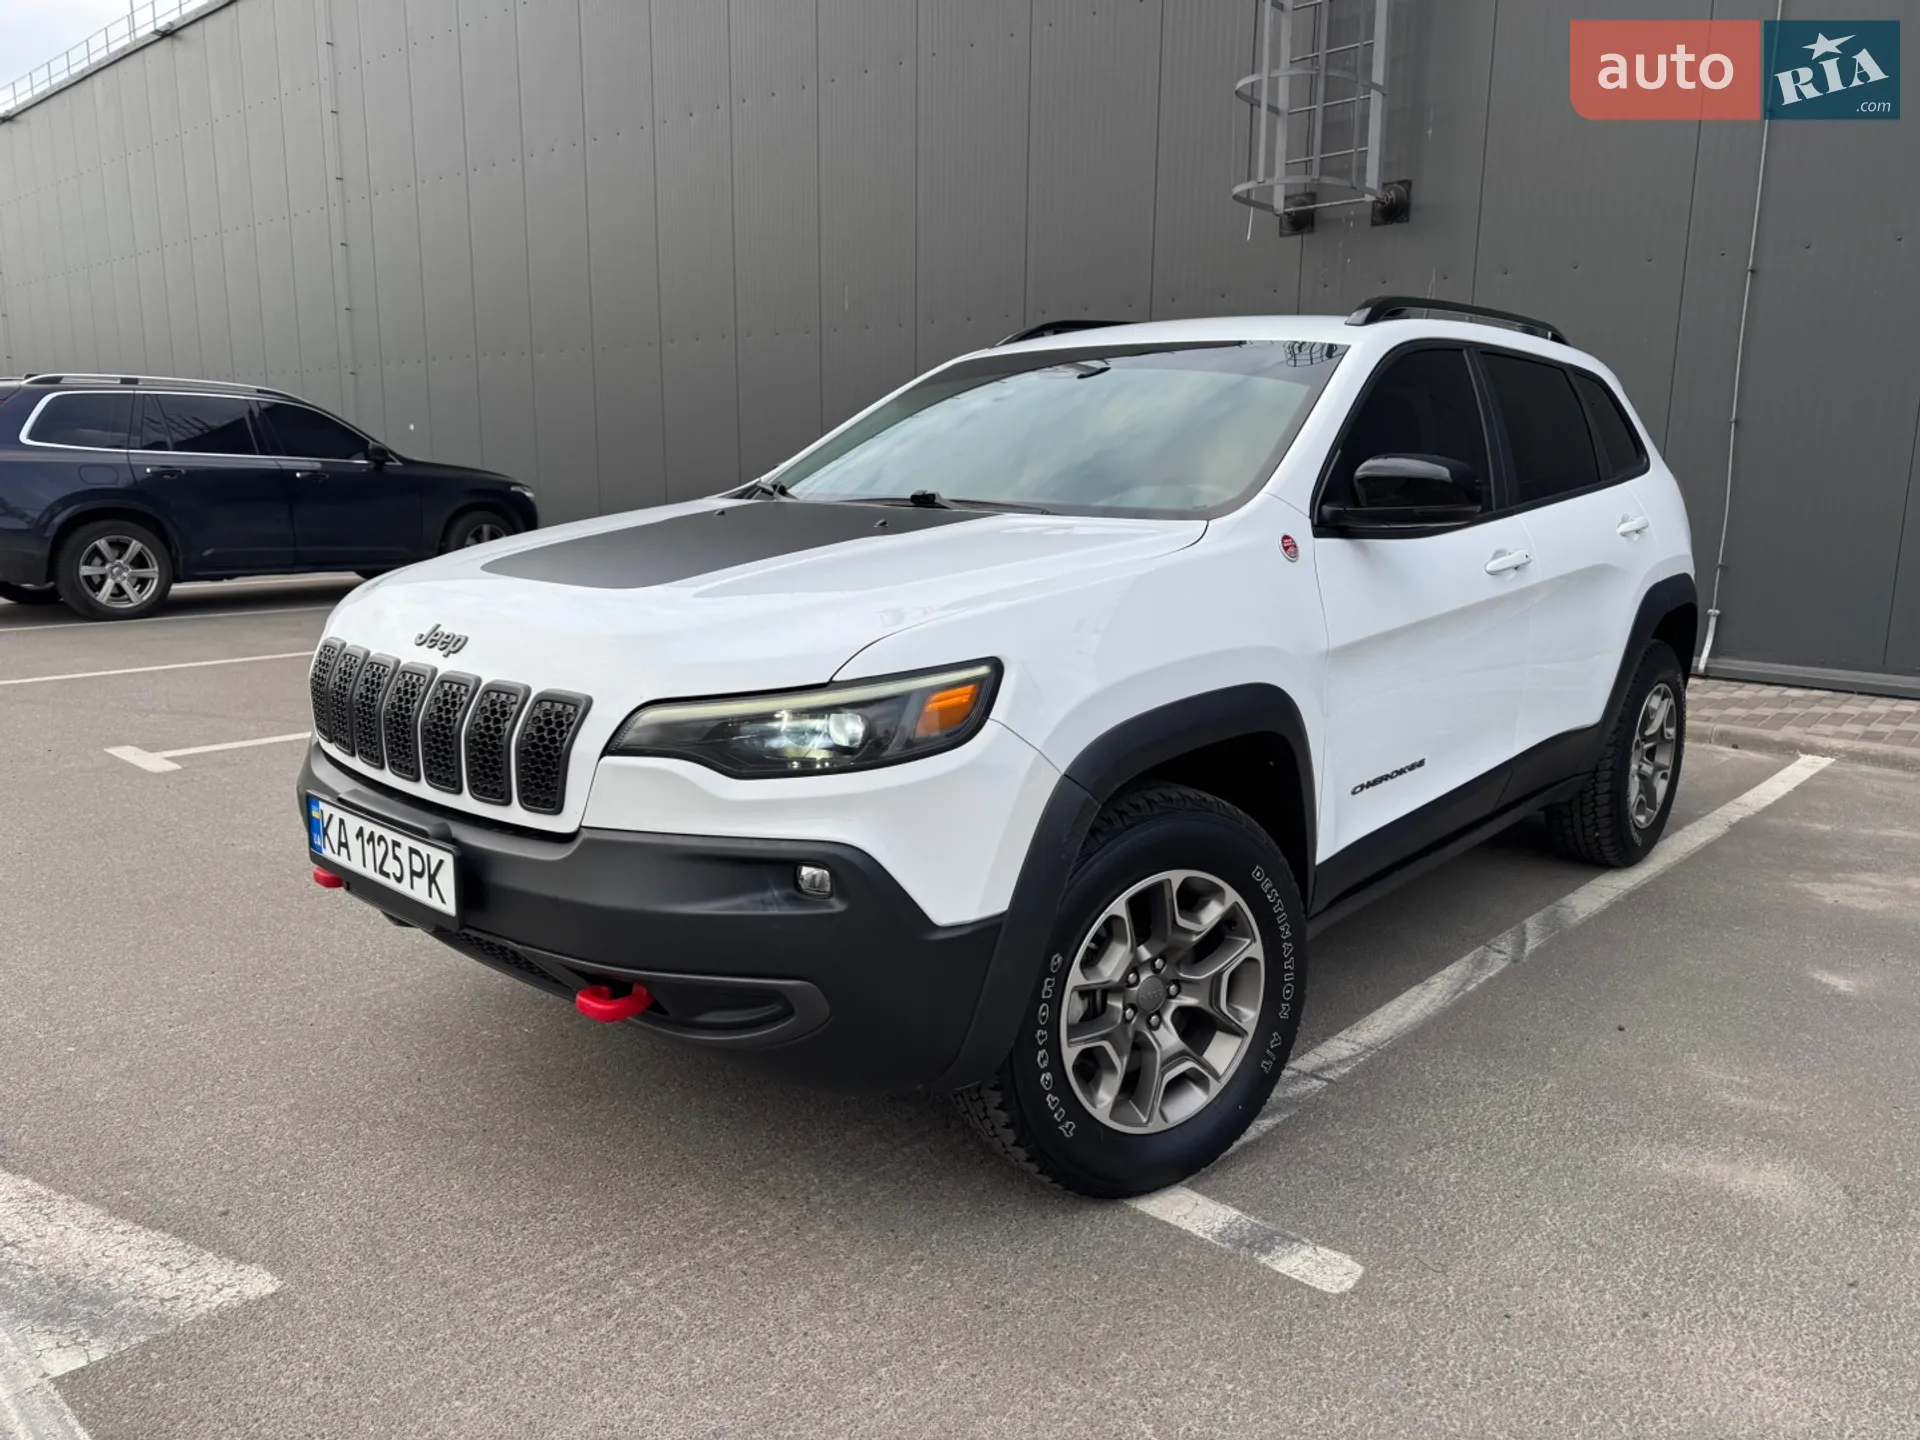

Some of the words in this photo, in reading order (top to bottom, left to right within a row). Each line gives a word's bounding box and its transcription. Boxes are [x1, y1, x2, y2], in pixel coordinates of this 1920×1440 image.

[414, 623, 469, 658] Jeep
[1350, 757, 1426, 796] CHEROKEE
[320, 809, 351, 862] KA
[355, 825, 404, 884] 1125
[408, 845, 447, 905] PK
[1251, 865, 1295, 1020] DESTINATION
[1260, 1031, 1282, 1075] A/T
